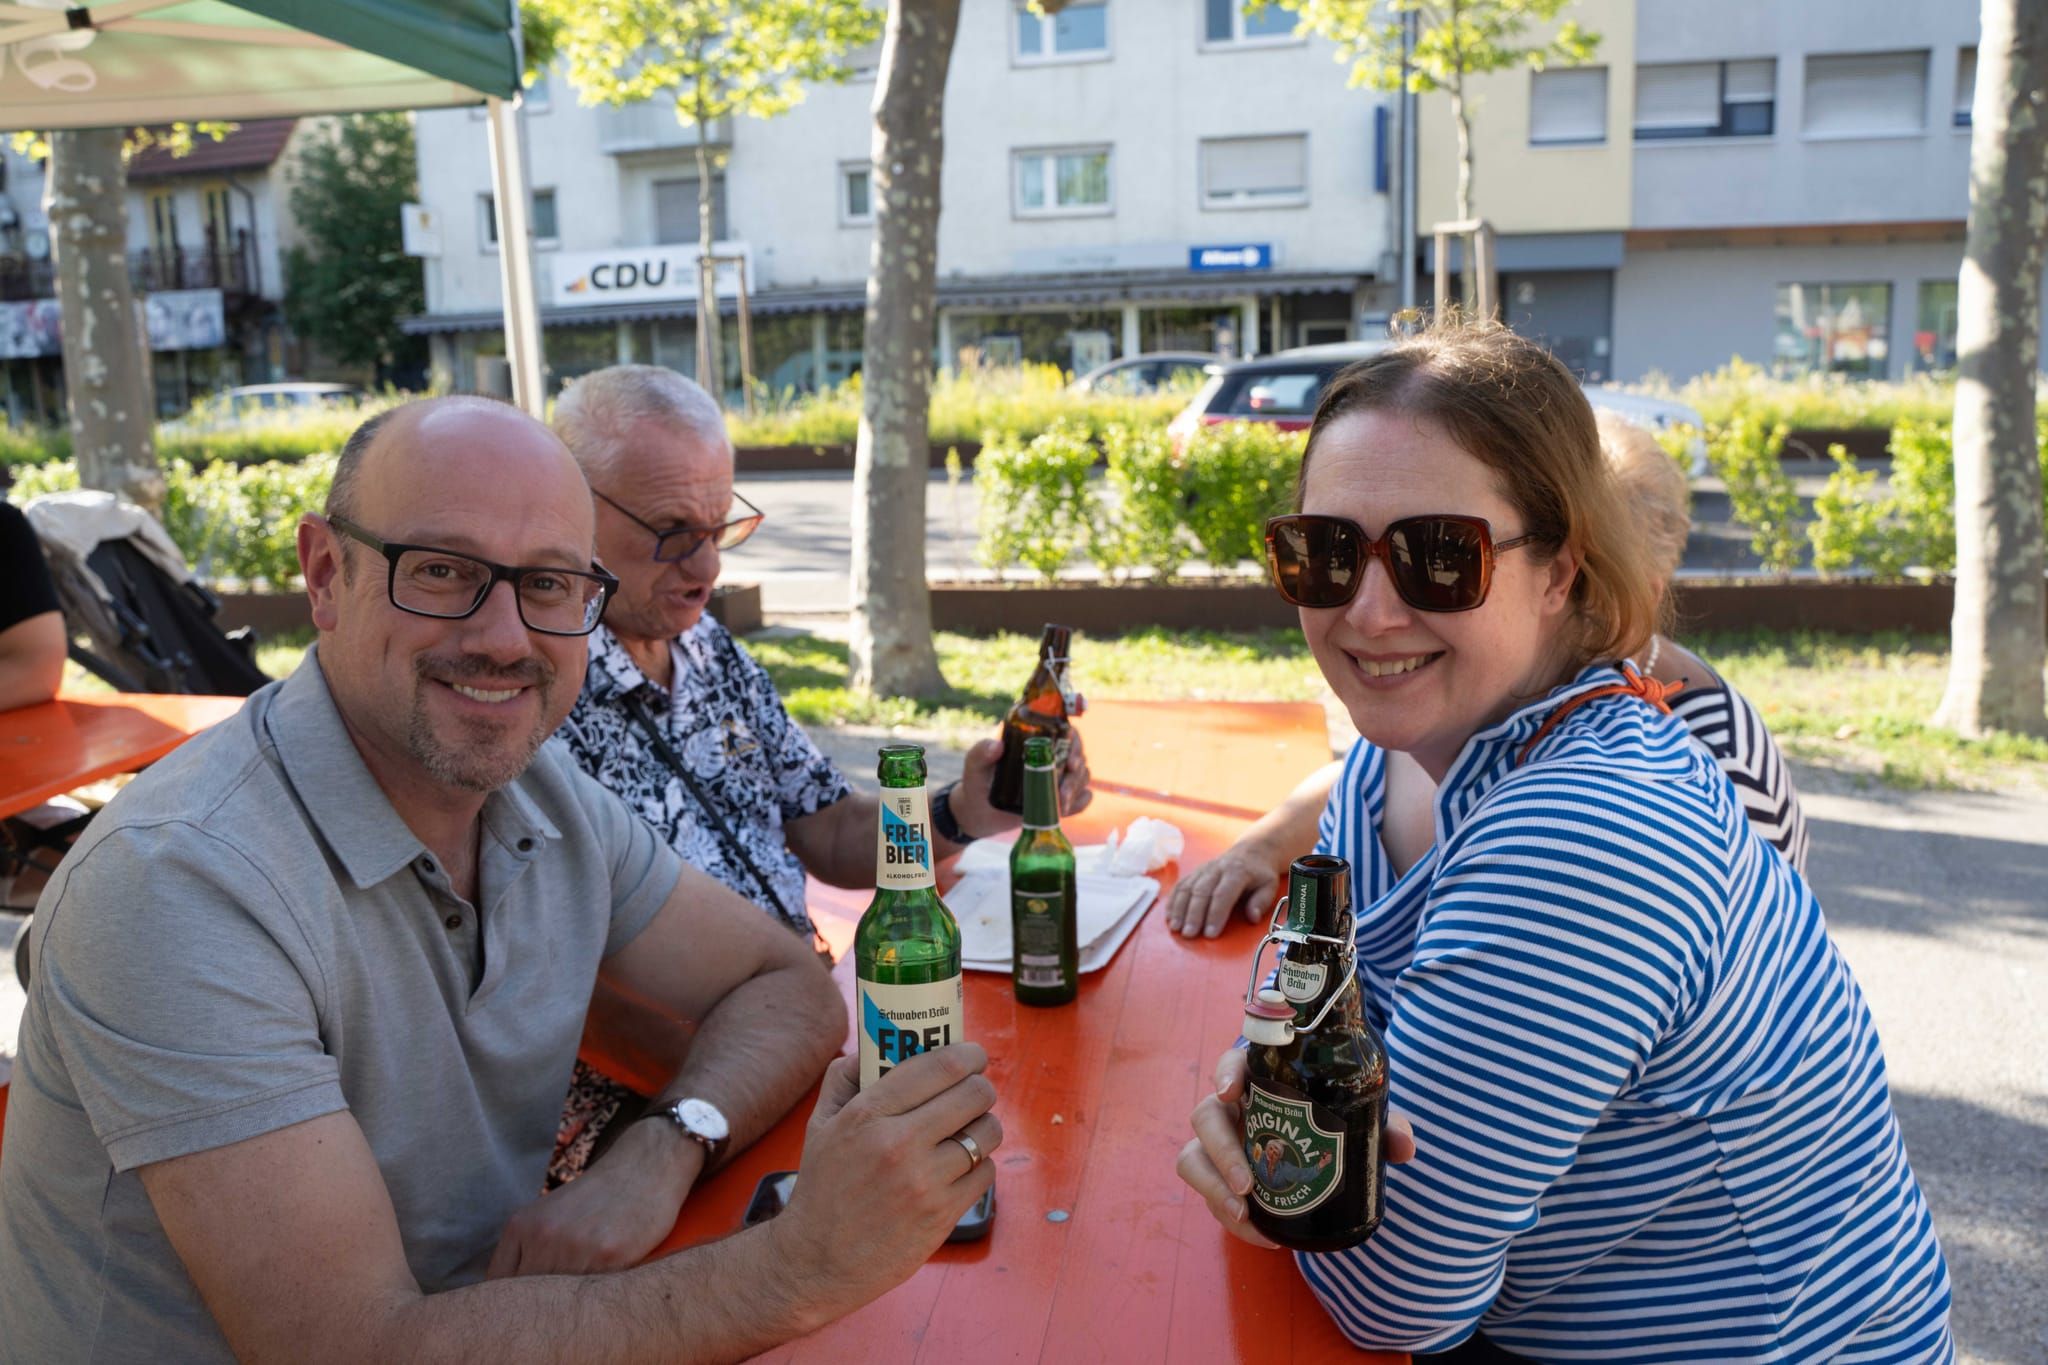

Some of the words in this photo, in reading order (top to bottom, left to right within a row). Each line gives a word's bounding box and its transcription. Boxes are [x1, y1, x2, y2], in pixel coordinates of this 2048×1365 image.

[590, 260, 668, 290] CDU
[886, 823, 925, 842] FREI
[885, 845, 926, 864] BIER
[1299, 883, 1308, 923] ORIGINAL
[1282, 964, 1320, 982] Schwaben
[1286, 977, 1306, 990] Bräu
[878, 1007, 928, 1020] Schwaben
[929, 1006, 950, 1018] Bräu
[878, 1024, 950, 1062] FREI
[1247, 1112, 1320, 1163] ORIGINAL
[1274, 1184, 1312, 1207] FRISCH
